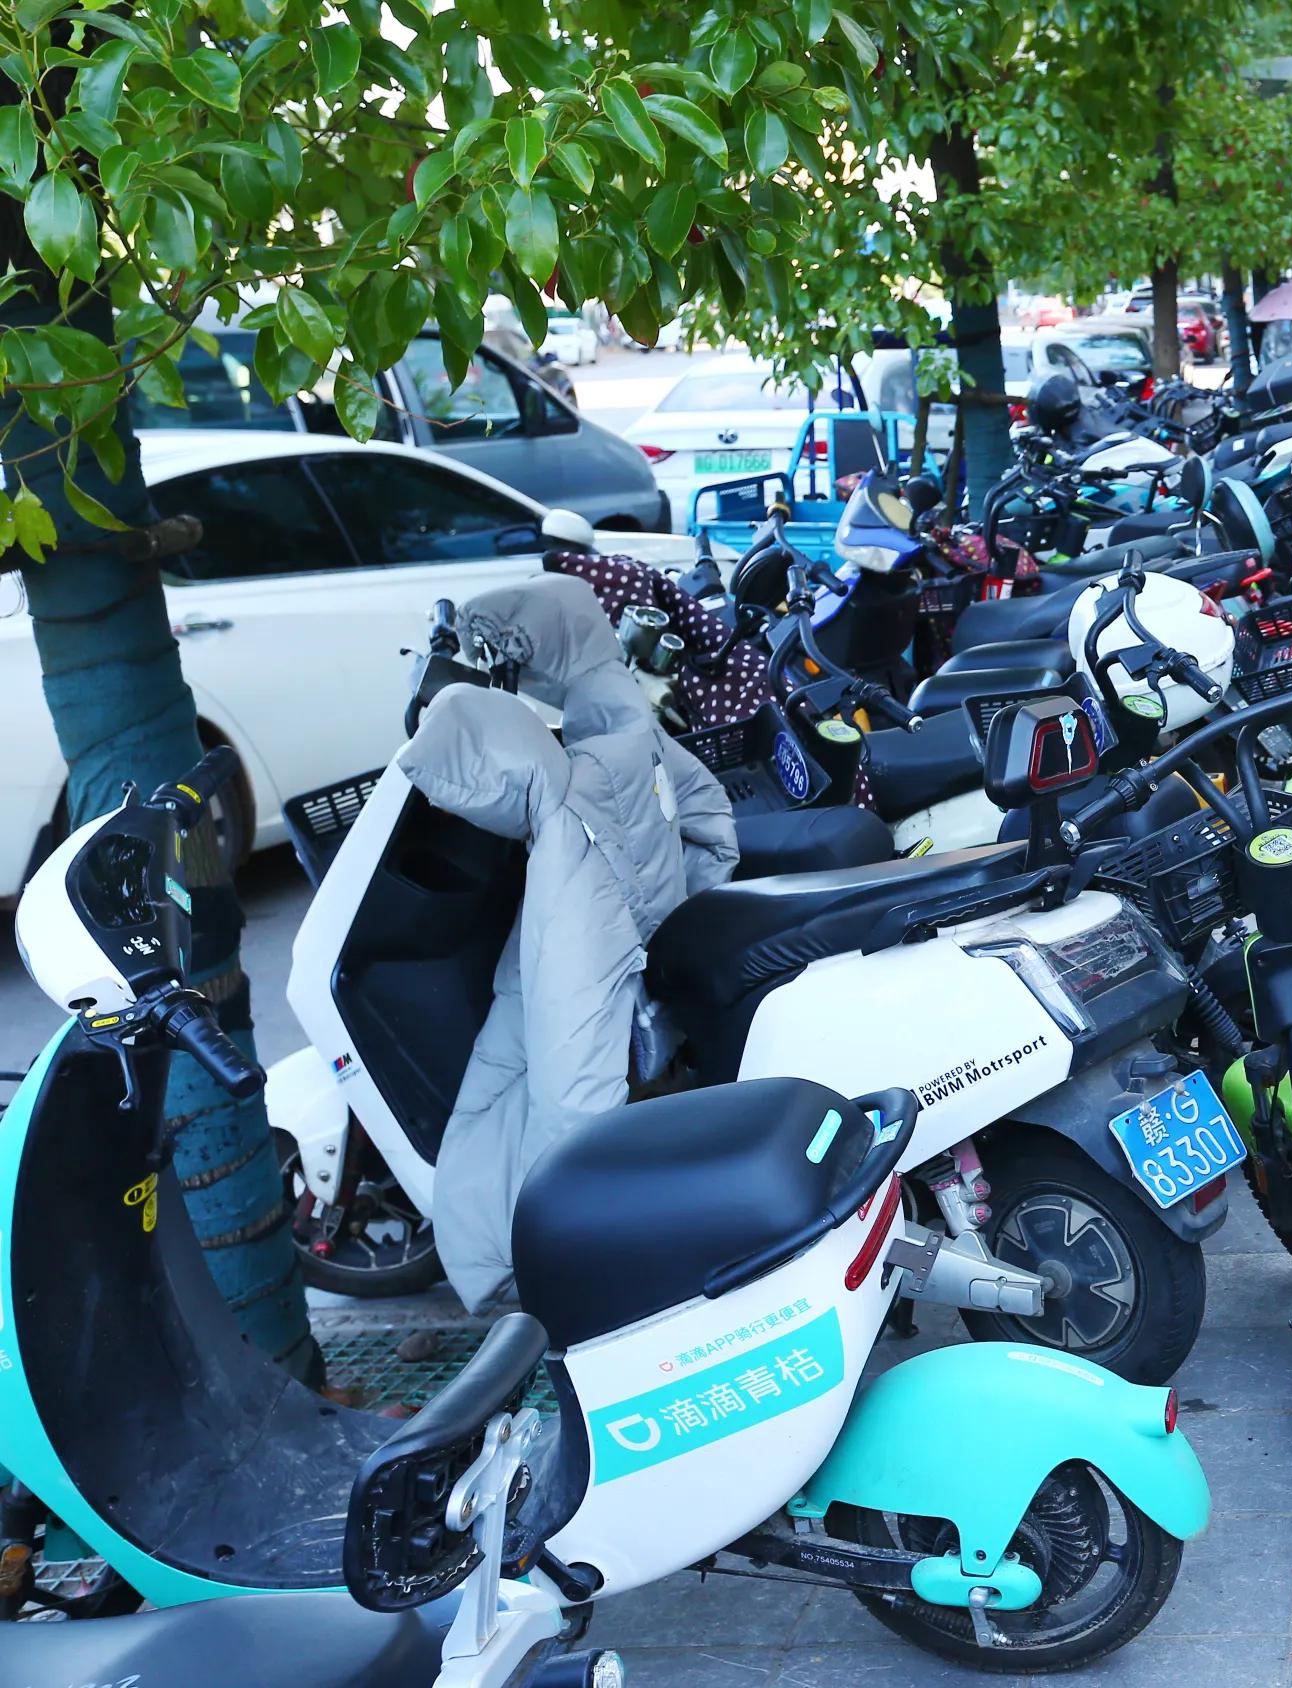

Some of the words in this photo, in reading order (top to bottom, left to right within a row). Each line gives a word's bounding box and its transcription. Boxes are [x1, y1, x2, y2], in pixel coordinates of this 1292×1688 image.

[130, 936, 155, 955] NFC
[918, 1065, 963, 1094] POWERED
[963, 1058, 977, 1071] BY
[922, 1076, 966, 1107] BWM
[965, 1034, 1048, 1085] Motrsport
[1142, 1115, 1242, 1198] 83307
[675, 1296, 813, 1368] 滴滴APP骑行更便宜
[658, 1346, 825, 1436] 滴滴青桔
